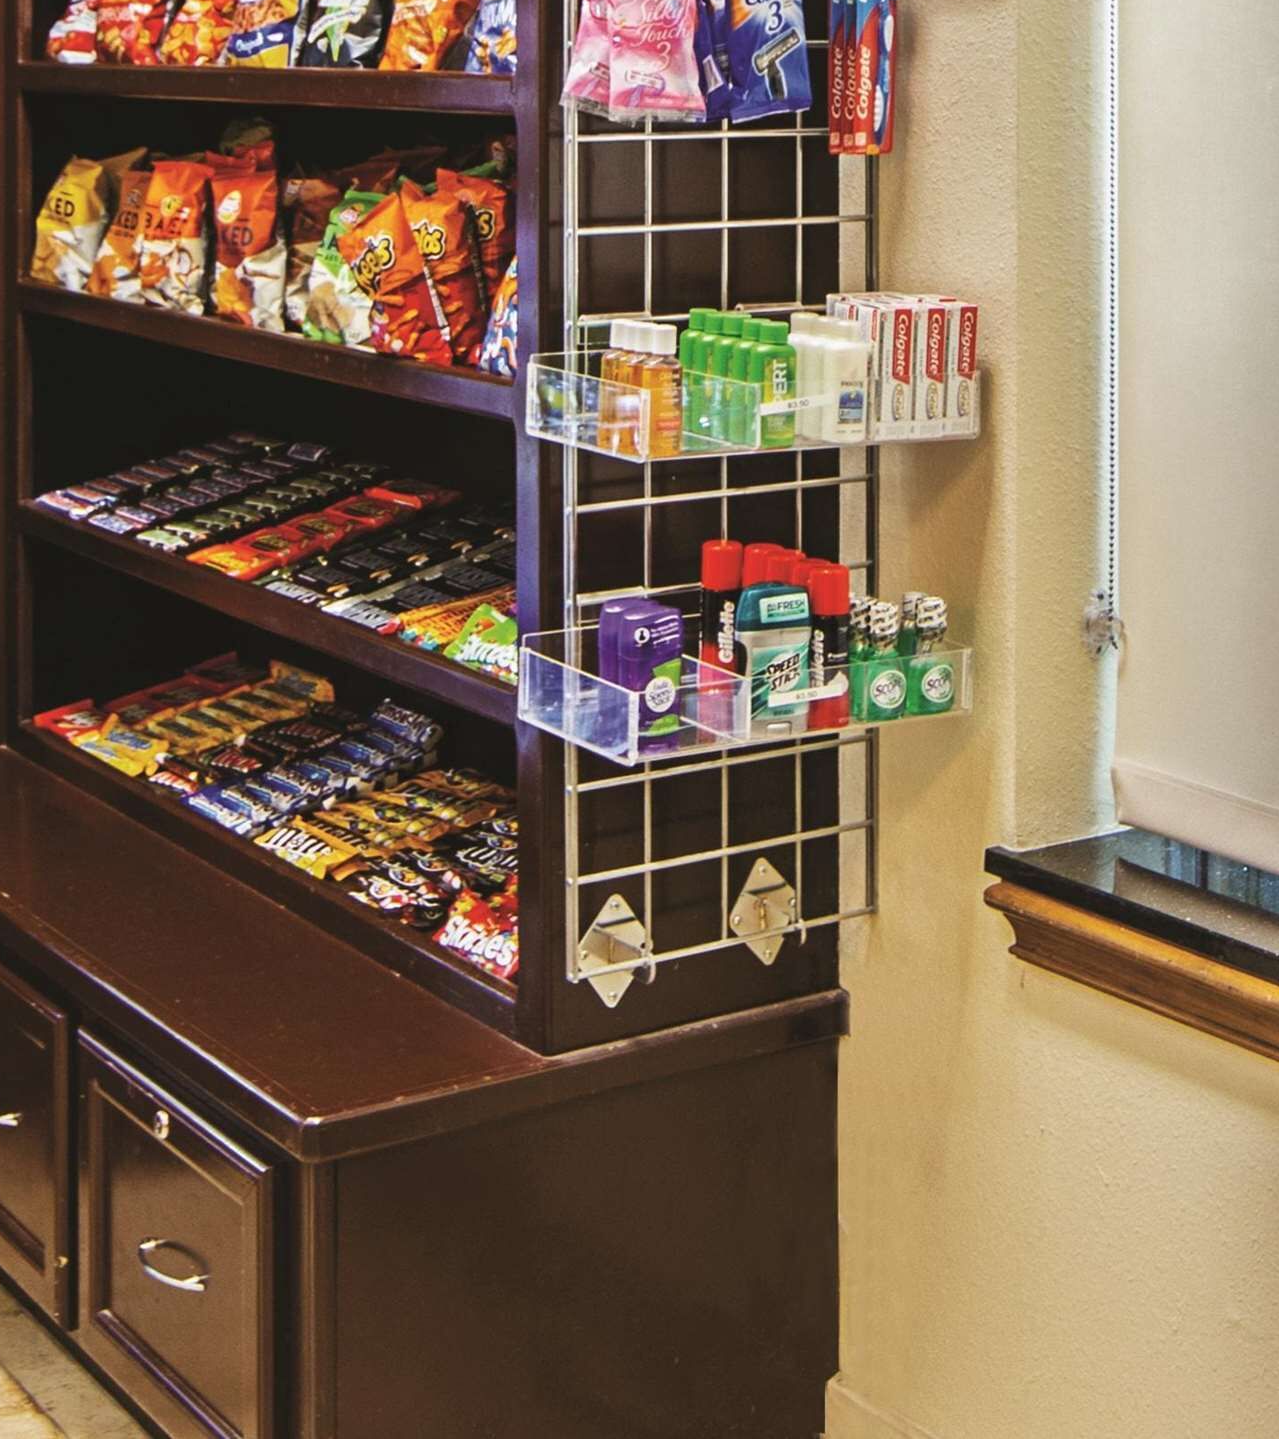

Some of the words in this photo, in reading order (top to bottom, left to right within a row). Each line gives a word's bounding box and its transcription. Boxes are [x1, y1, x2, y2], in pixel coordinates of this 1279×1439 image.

[766, 1, 783, 32] 3
[832, 47, 844, 119] Colgate
[856, 45, 872, 120] Colgate
[895, 313, 910, 377] Colgate
[928, 312, 943, 376] Colgate
[960, 311, 974, 375] Colgate
[718, 600, 735, 663] Gillette
[767, 653, 801, 675] SPEED
